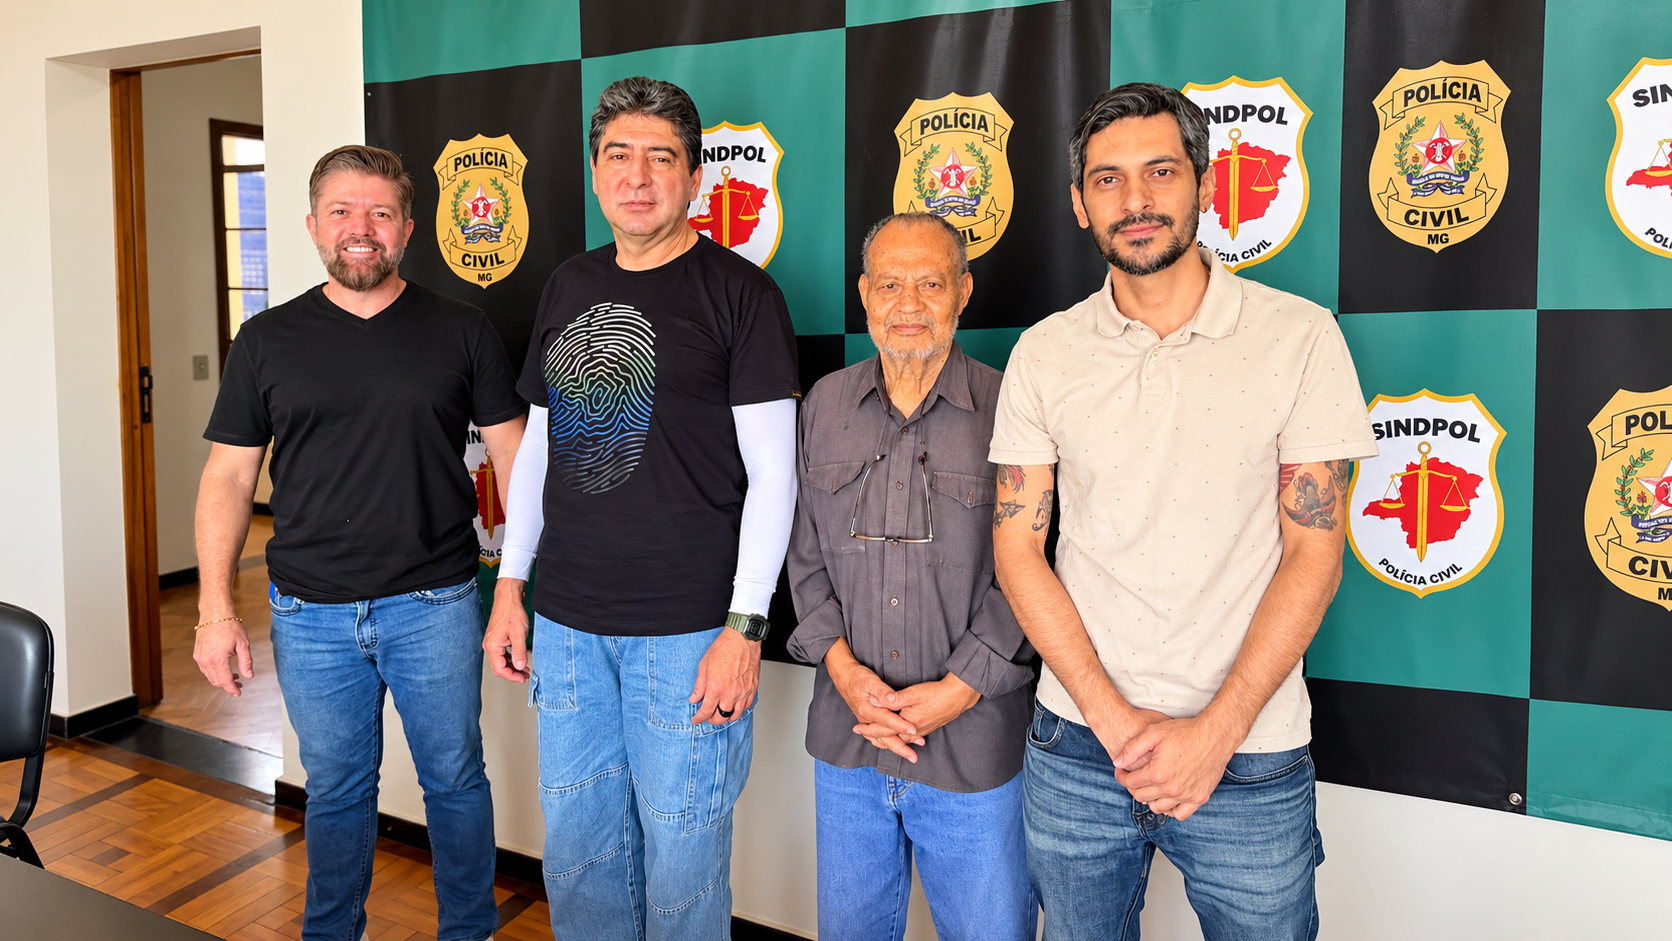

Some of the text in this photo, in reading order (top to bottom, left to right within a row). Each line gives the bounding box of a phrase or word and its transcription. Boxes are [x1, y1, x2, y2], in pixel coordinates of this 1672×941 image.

[1403, 78, 1482, 107] POLÍCIA
[920, 108, 989, 135] POLÍCIA
[454, 148, 508, 172] POLÍCIA
[702, 145, 766, 164] NDPOL
[1404, 207, 1469, 227] CIVIL
[1241, 239, 1272, 260] CIVIL
[1427, 233, 1450, 245] MG
[461, 252, 505, 268] CIVIL
[477, 273, 492, 282] MG
[1372, 418, 1481, 443] SINDPOL
[1378, 557, 1463, 586] POLÍCIA CIVIL
